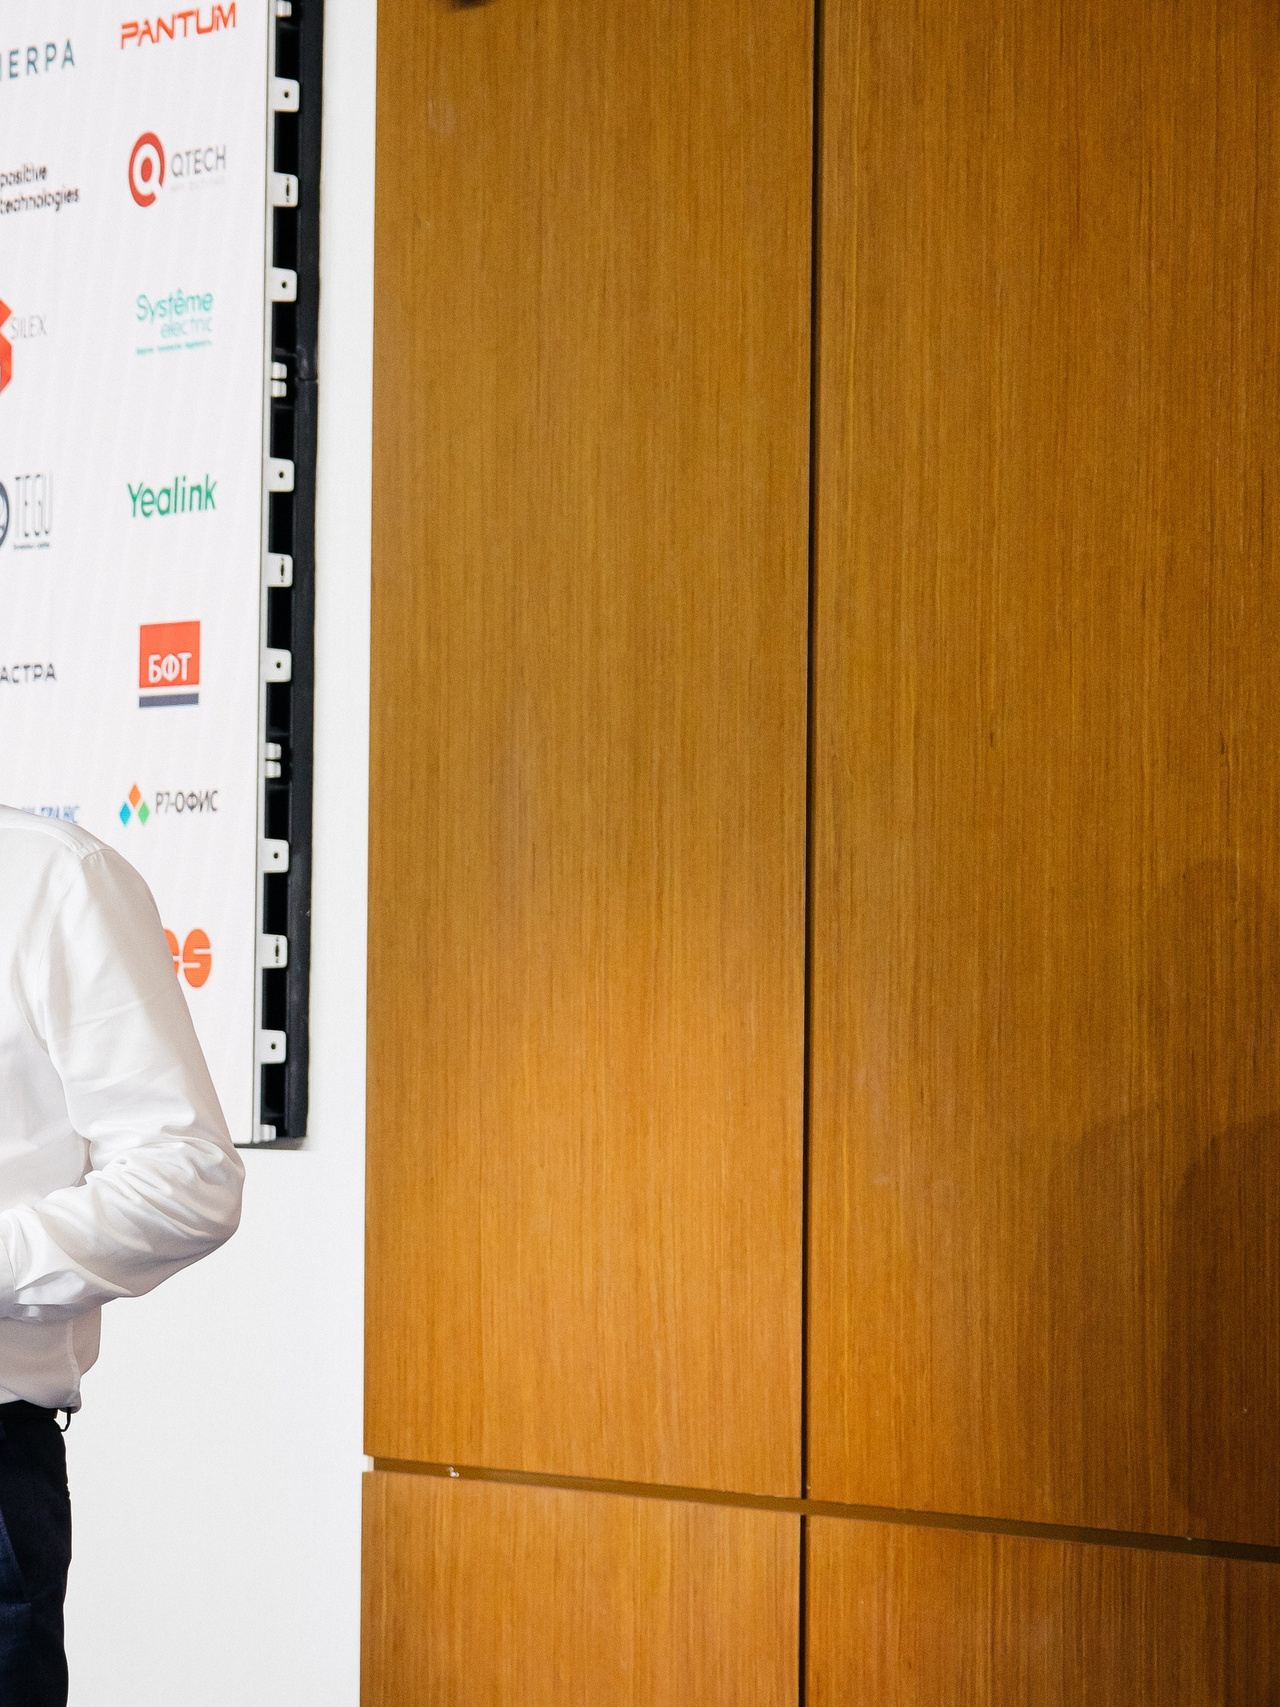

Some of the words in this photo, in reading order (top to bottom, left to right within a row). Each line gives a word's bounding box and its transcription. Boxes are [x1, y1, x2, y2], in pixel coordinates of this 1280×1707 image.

[121, 1, 237, 49] PANTUM
[0, 164, 48, 189] positive
[170, 145, 227, 177] QTECH
[0, 188, 80, 215] technologies
[127, 474, 218, 518] Yealink
[148, 652, 193, 683] БФТ
[155, 790, 218, 814] Р7-ОФИС
